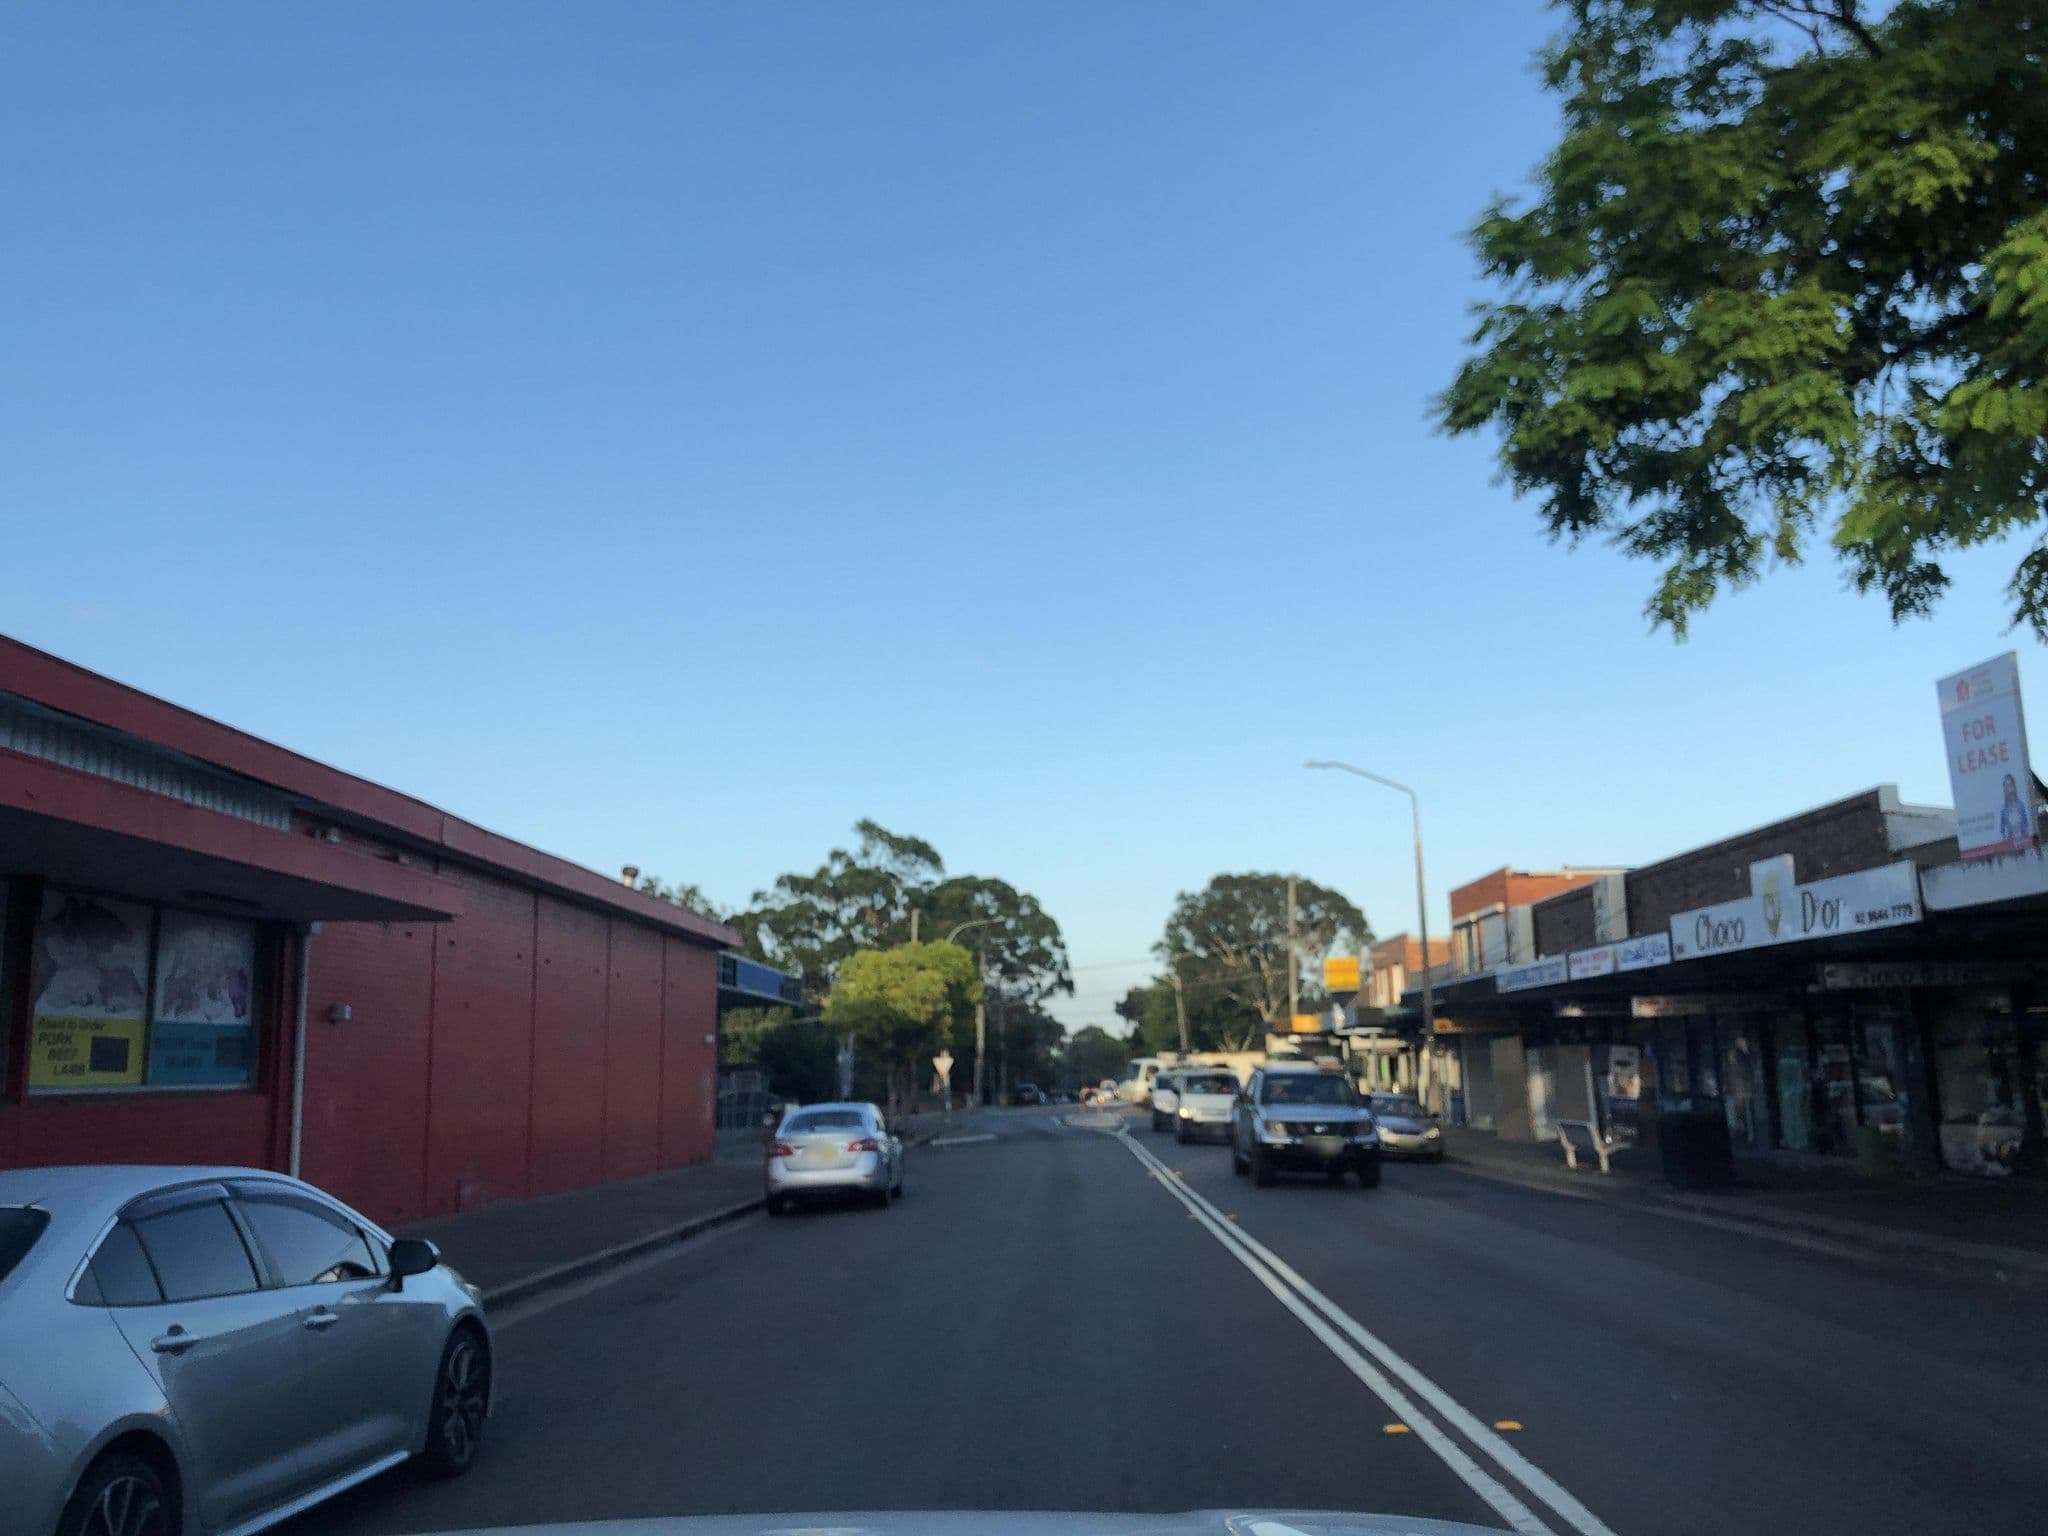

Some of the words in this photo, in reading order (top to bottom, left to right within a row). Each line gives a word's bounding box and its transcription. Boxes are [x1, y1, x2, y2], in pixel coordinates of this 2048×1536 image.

[1961, 715, 1996, 744] FOR
[1957, 742, 2009, 774] LEASE
[1695, 914, 1745, 951] Choco
